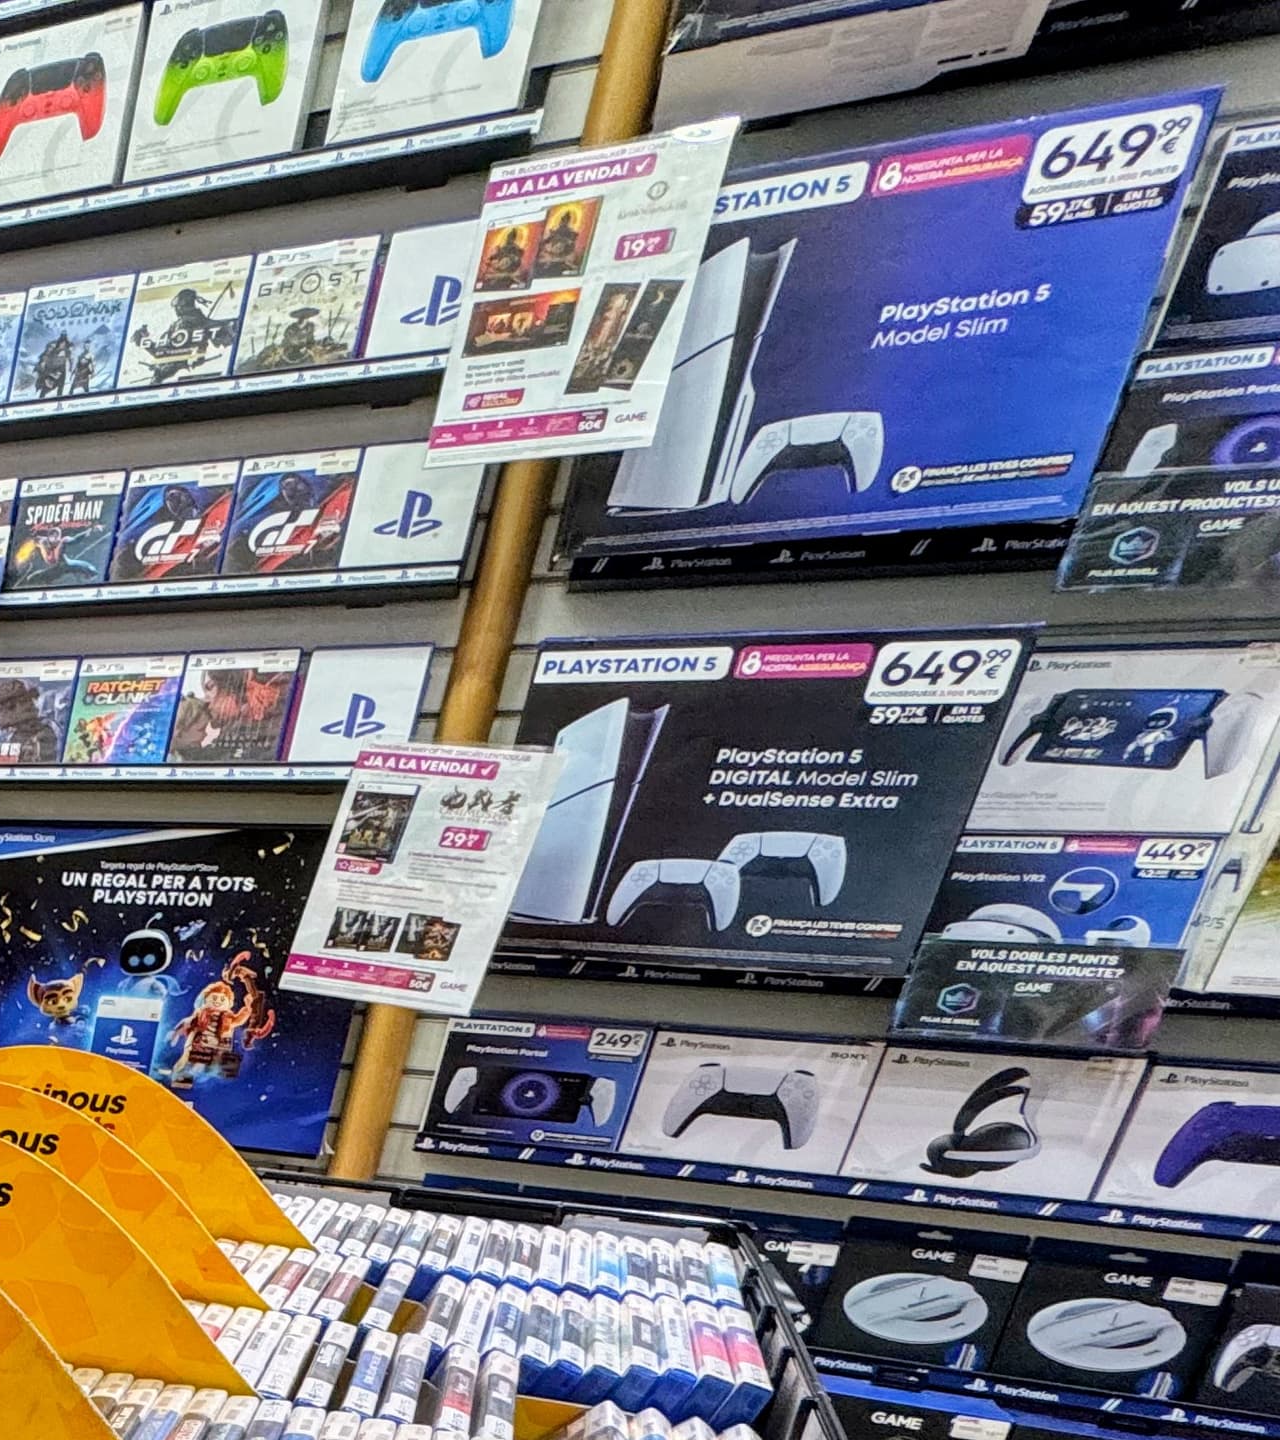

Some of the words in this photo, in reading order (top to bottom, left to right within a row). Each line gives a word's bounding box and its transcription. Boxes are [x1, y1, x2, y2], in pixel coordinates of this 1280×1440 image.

[1161, 135, 1177, 154] €
[496, 181, 520, 198] JA
[521, 179, 534, 193] A
[537, 177, 558, 192] LA
[562, 163, 629, 187] VENDA!
[258, 269, 367, 298] GHOST
[880, 288, 1027, 323] PlayStation
[1035, 284, 1051, 301] 5
[139, 327, 220, 349] GHOST
[871, 322, 949, 349] Model
[954, 317, 1008, 338] Slim
[1145, 356, 1252, 373] PLAYSTATION
[1256, 352, 1267, 363] 5
[25, 500, 103, 525] SPIDER-MAN
[543, 658, 697, 676] PLAYSTATION
[703, 657, 717, 672] 5
[984, 665, 1001, 680] €
[87, 678, 166, 694] RATCHET
[364, 756, 383, 767] JA
[384, 757, 396, 767] A
[399, 758, 417, 770] LA
[421, 760, 476, 775] VENDA!
[716, 748, 844, 766] PlayStation
[848, 749, 862, 764] 5
[710, 769, 791, 785] DIGITAL
[796, 770, 867, 787] Model
[871, 770, 918, 787] Slim
[703, 793, 715, 806] +
[719, 791, 833, 808] DualSense
[838, 793, 899, 809] Extra
[61, 871, 87, 887] UN
[91, 873, 147, 889] REGAL
[152, 873, 186, 889] PER
[189, 875, 203, 890] A
[206, 876, 254, 891] TOTS
[93, 890, 213, 907] PLAYSTATION
[971, 949, 1007, 961] VOLS
[1009, 949, 1066, 963] DOBLES
[1069, 952, 1119, 966] PUNTS
[956, 961, 977, 972] EN
[980, 961, 1035, 975] AQUEST
[1038, 964, 1124, 978] PRODUCTE?
[466, 1044, 517, 1056] PlayStation
[519, 1048, 548, 1056] Portal
[912, 1248, 956, 1263] GAME
[1104, 1272, 1153, 1288] GAME
[871, 1411, 923, 1430] GAME
